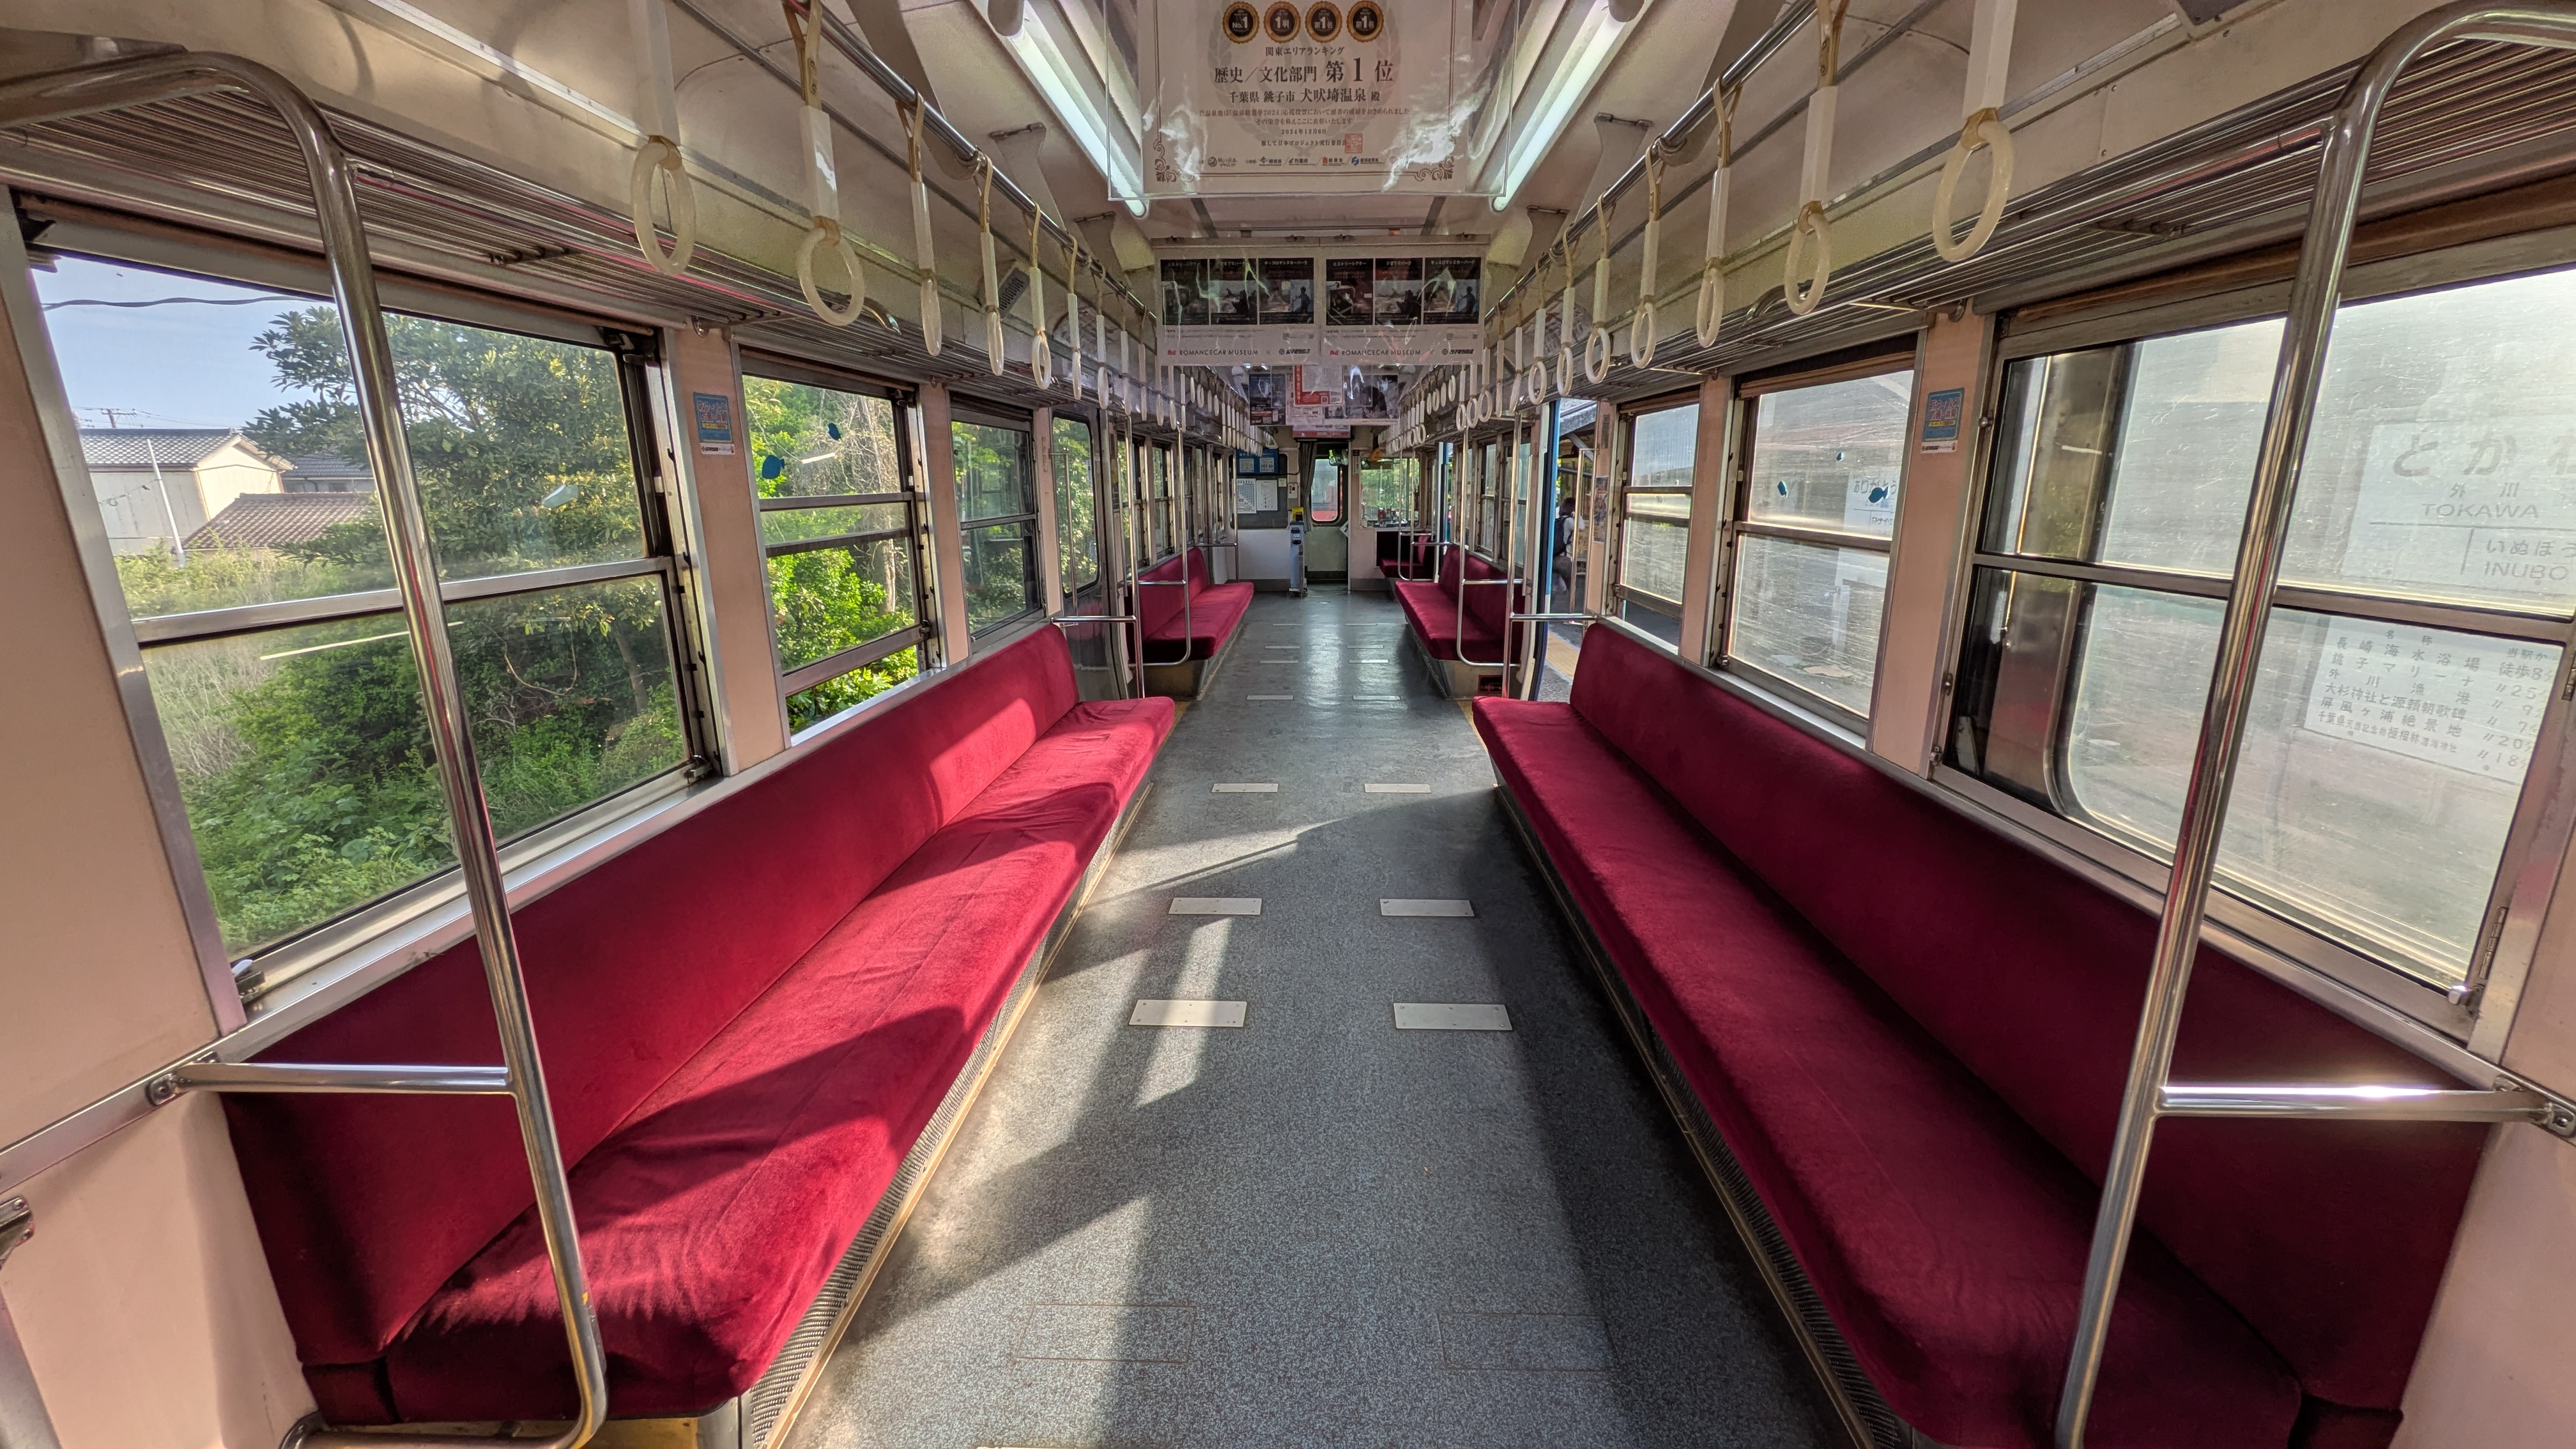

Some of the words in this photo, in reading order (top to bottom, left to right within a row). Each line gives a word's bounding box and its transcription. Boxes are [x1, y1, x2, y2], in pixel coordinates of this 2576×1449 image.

[1232, 16, 1248, 29] No.1
[1266, 47, 1345, 56] 関東エリアランキング
[1229, 91, 1259, 103] 千葉県
[1264, 91, 1295, 103] 銚子市
[1300, 88, 1366, 102] 犬吠埼温泉
[1370, 91, 1380, 102] 殿
[2450, 482, 2520, 498] 外川
[2422, 503, 2539, 518] TOKAWA
[2484, 562, 2569, 581] INUBO
[2385, 630, 2433, 646] 名称
[2336, 636, 2481, 672] 長崎海水浴場
[2331, 652, 2474, 687] 銚子マリーナ
[2329, 668, 2471, 705] 外川漁港
